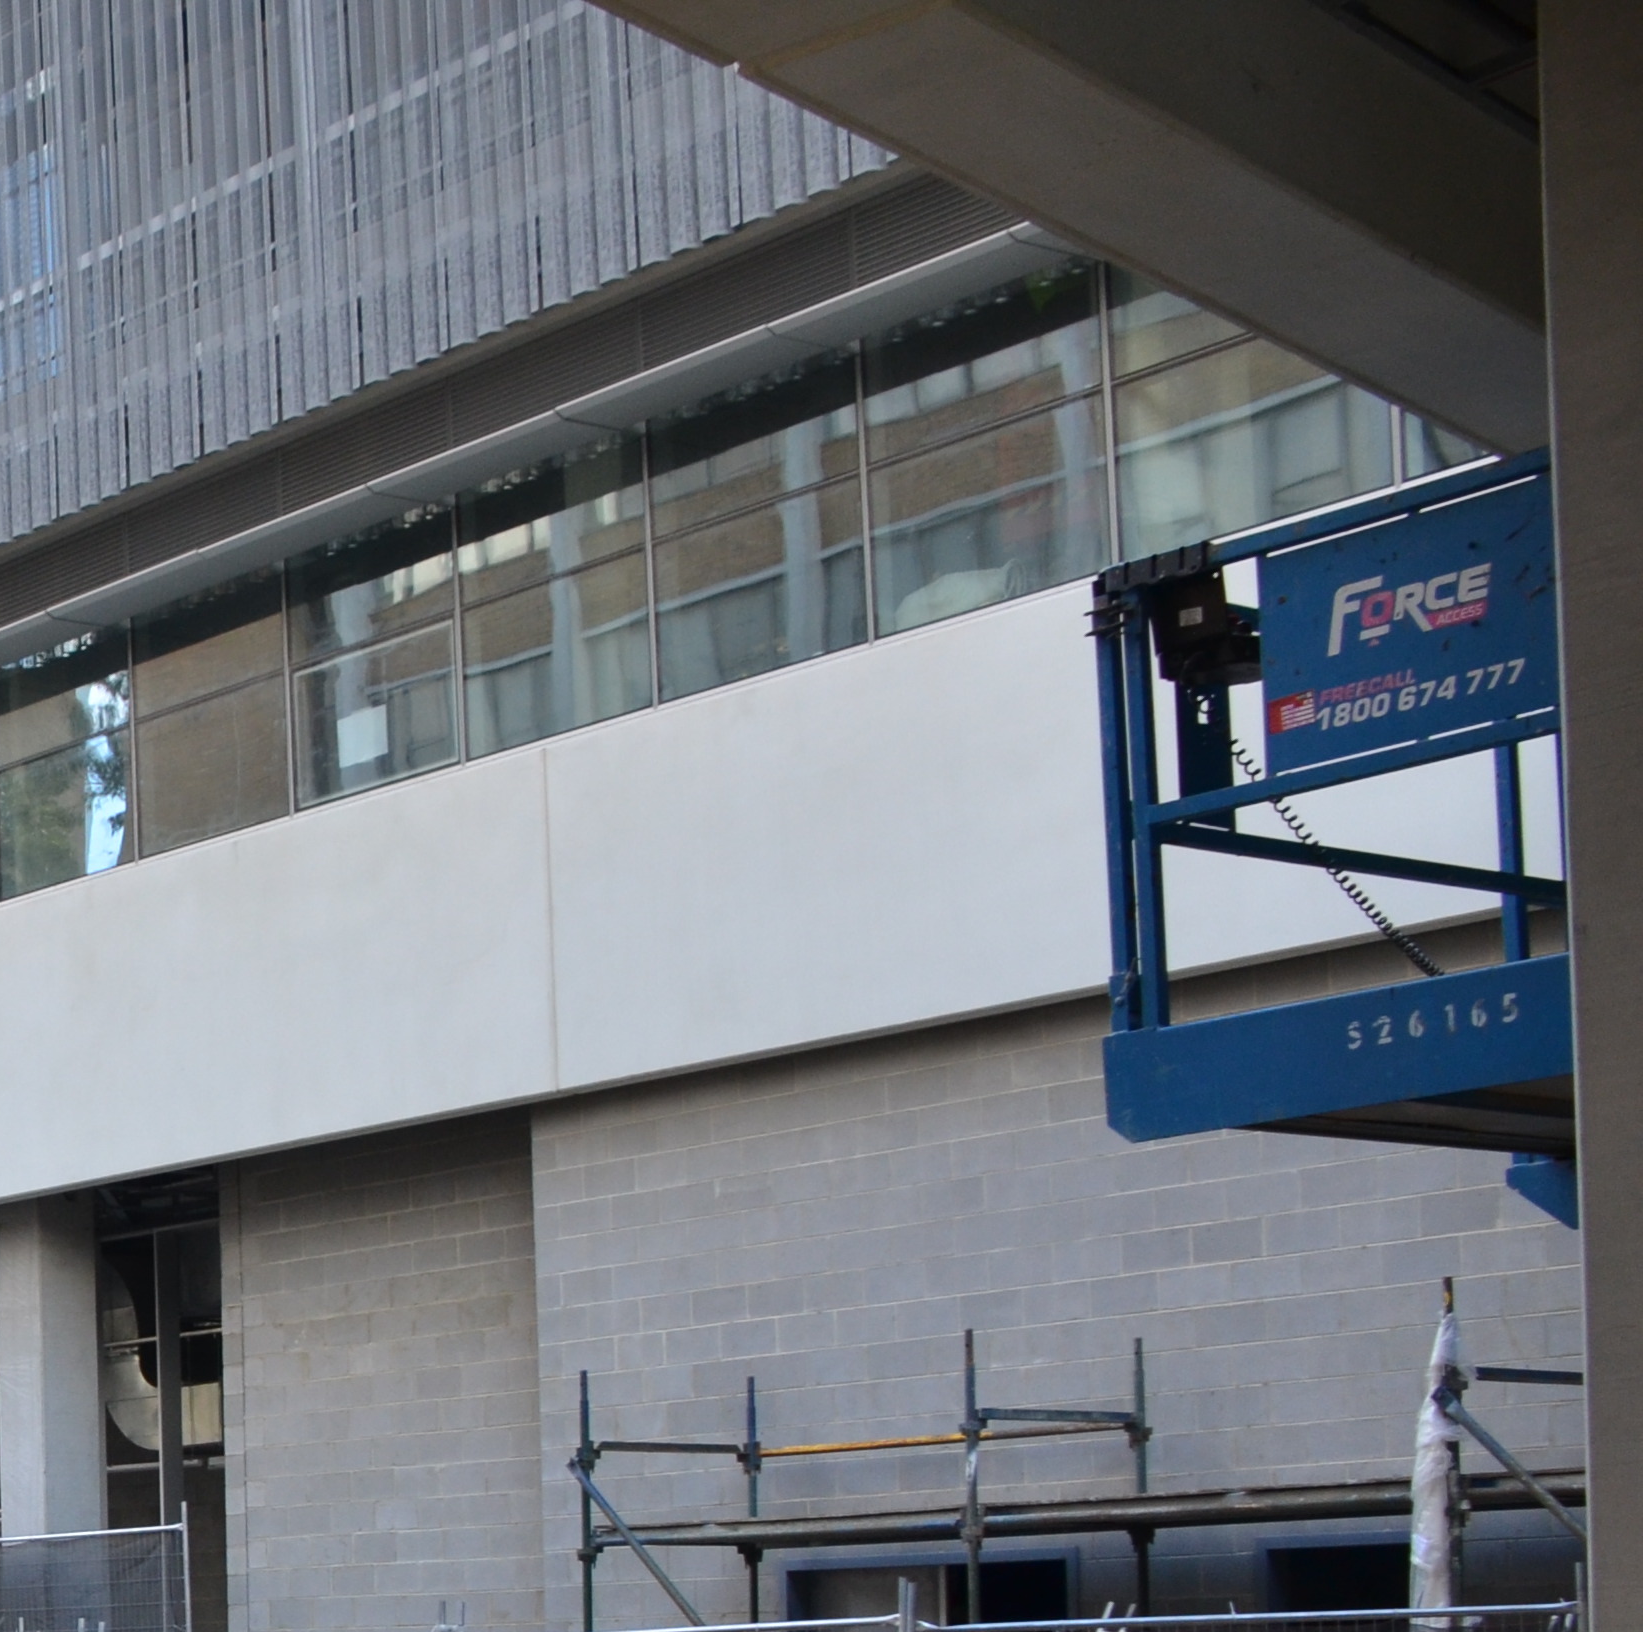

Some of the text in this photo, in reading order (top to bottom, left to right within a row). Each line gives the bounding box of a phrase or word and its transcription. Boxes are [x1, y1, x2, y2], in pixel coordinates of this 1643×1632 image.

[1327, 562, 1492, 657] FORCE
[1435, 604, 1484, 626] ACCESS
[1316, 657, 1526, 731] 1800 674 777
[1319, 668, 1417, 704] FREECALL
